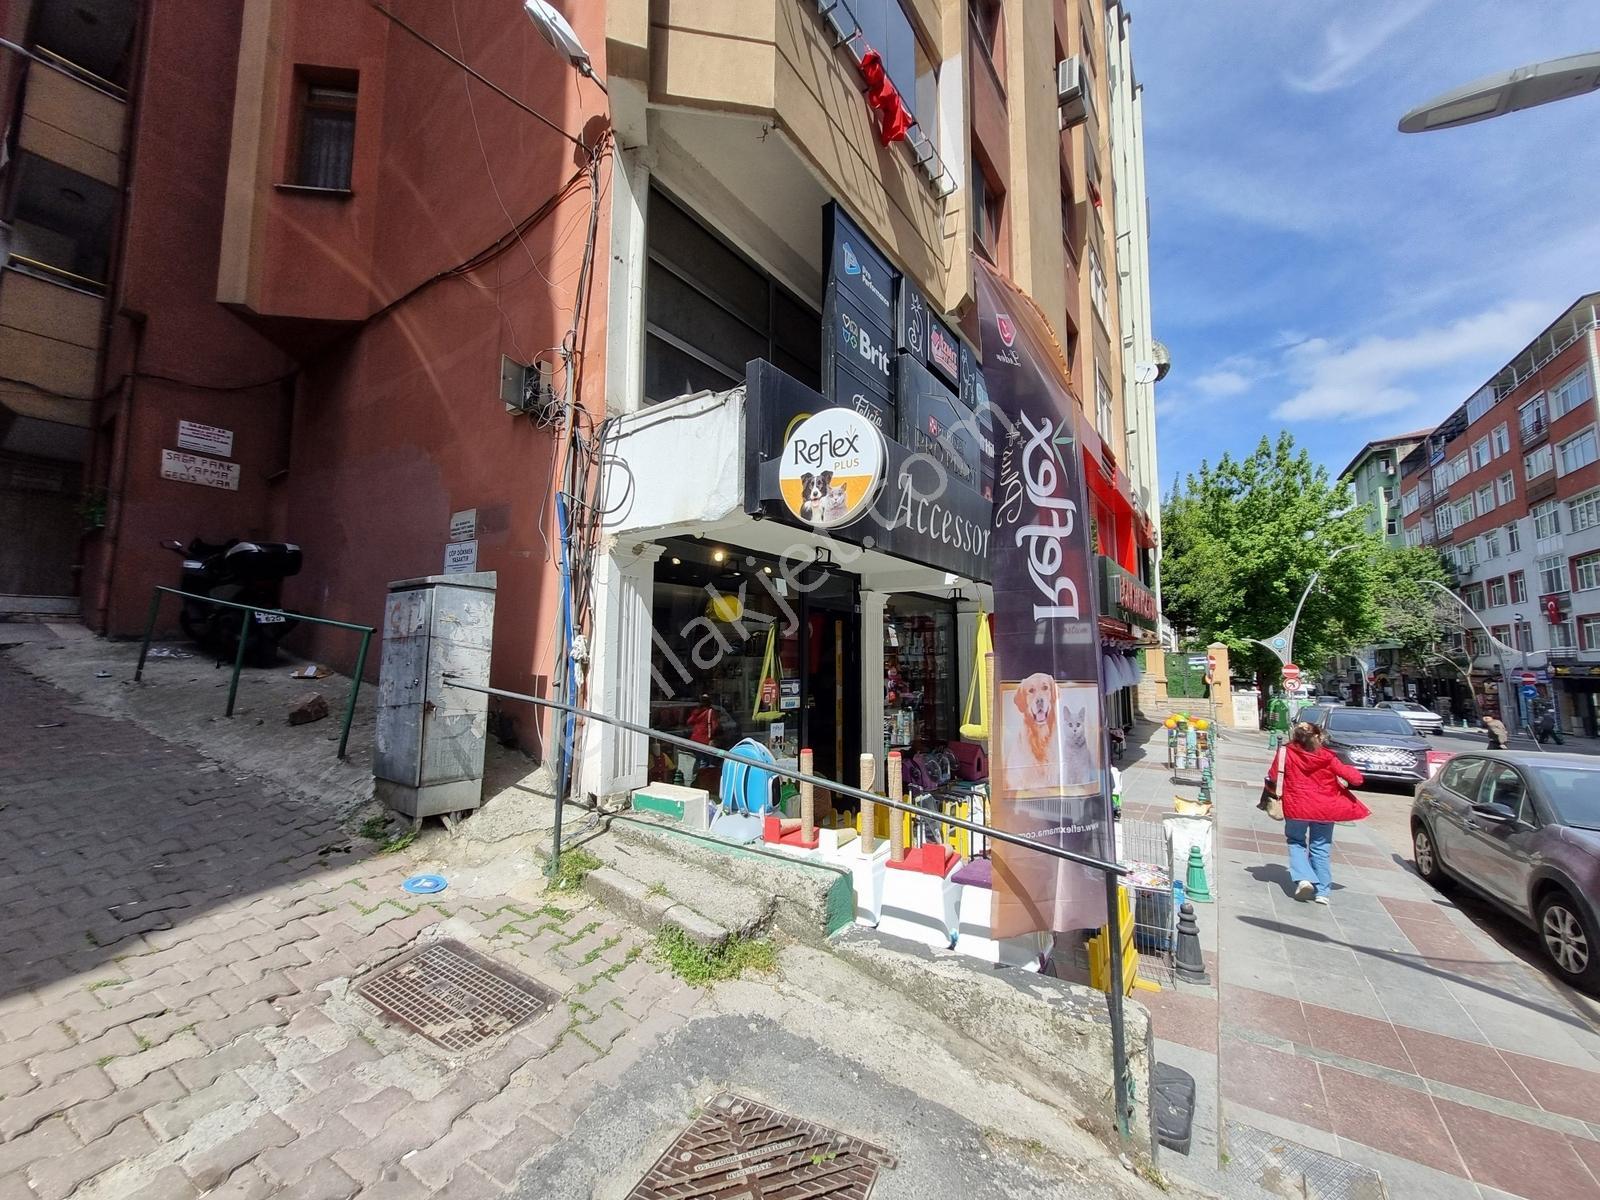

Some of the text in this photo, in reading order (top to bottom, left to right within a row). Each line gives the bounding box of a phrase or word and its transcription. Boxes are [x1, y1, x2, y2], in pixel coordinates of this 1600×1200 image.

[859, 329, 890, 376] Brit
[852, 394, 882, 428] Felicia
[794, 430, 859, 468] Reflex
[202, 459, 234, 472] PARK
[834, 458, 859, 471] PLUS
[184, 465, 229, 479] YAPMA
[206, 478, 230, 489] VAR
